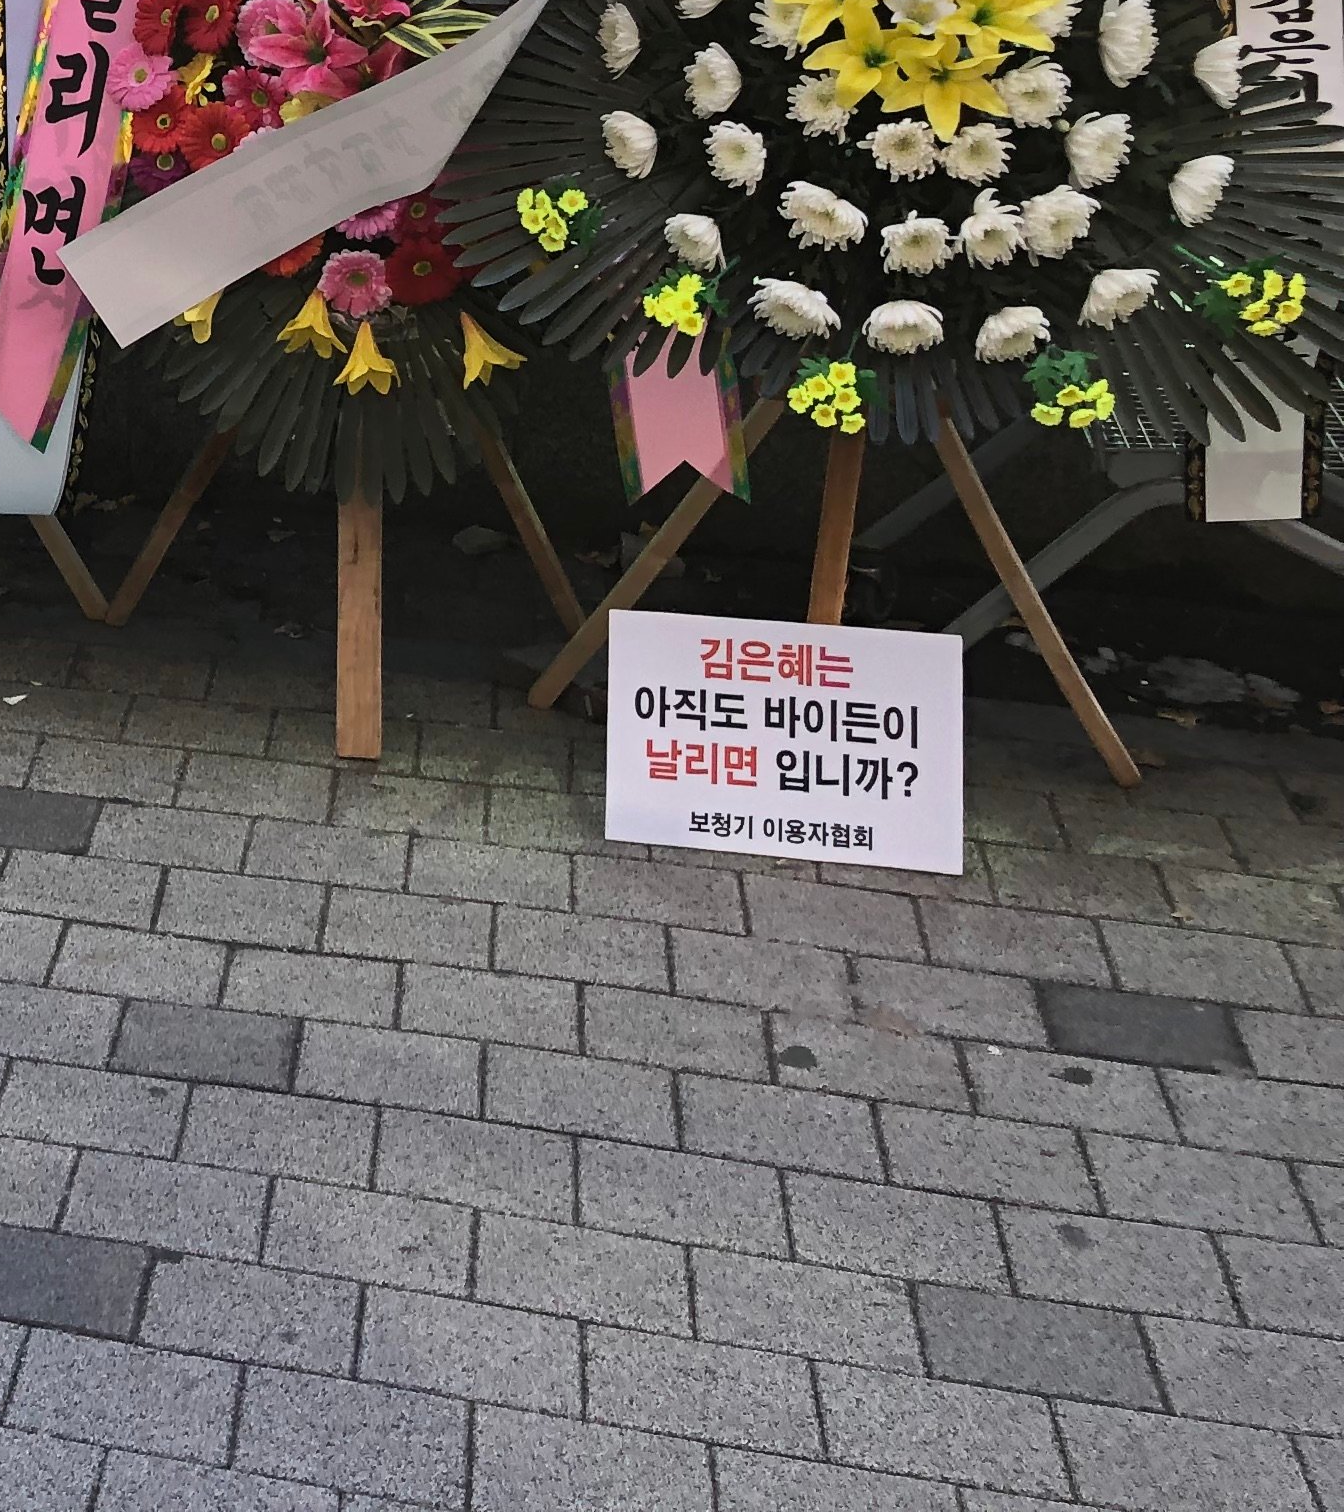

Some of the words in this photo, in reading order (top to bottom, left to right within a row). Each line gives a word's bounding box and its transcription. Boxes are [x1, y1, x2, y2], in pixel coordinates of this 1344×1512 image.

[700, 637, 855, 689] 김은혜는
[634, 686, 748, 731] 아직도
[765, 695, 919, 749] 바이든이
[645, 738, 758, 787] 날리면
[775, 749, 920, 800] 입니까?
[688, 810, 754, 840] 보청기
[763, 817, 875, 852] 이용자협회
